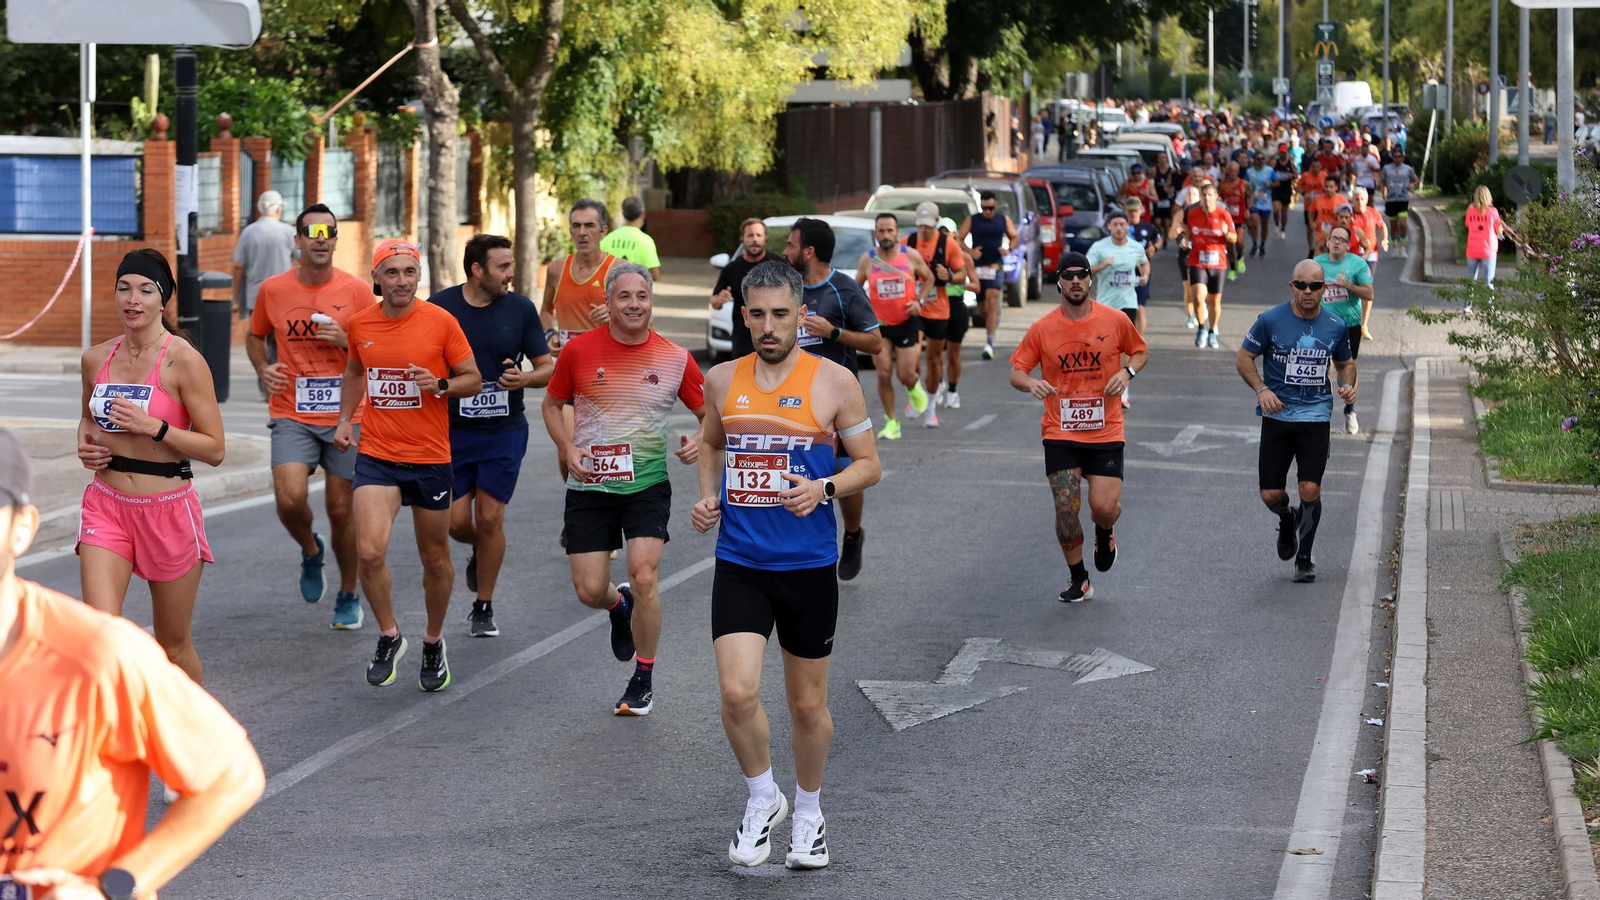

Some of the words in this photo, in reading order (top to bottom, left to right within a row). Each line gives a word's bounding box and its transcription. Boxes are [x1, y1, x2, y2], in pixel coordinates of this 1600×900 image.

[286, 319, 318, 337] XX
[1296, 365, 1317, 376] 645
[308, 389, 333, 401] 589
[379, 382, 407, 396] 408
[472, 393, 497, 406] 600
[103, 399, 113, 416] 8
[1071, 409, 1094, 420] 489
[725, 433, 814, 452] CAPA
[593, 457, 619, 472] 564
[737, 470, 771, 490] 132
[94, 480, 115, 497] UNDER
[114, 493, 152, 505] ARMOUR
[158, 490, 187, 502] UNDER
